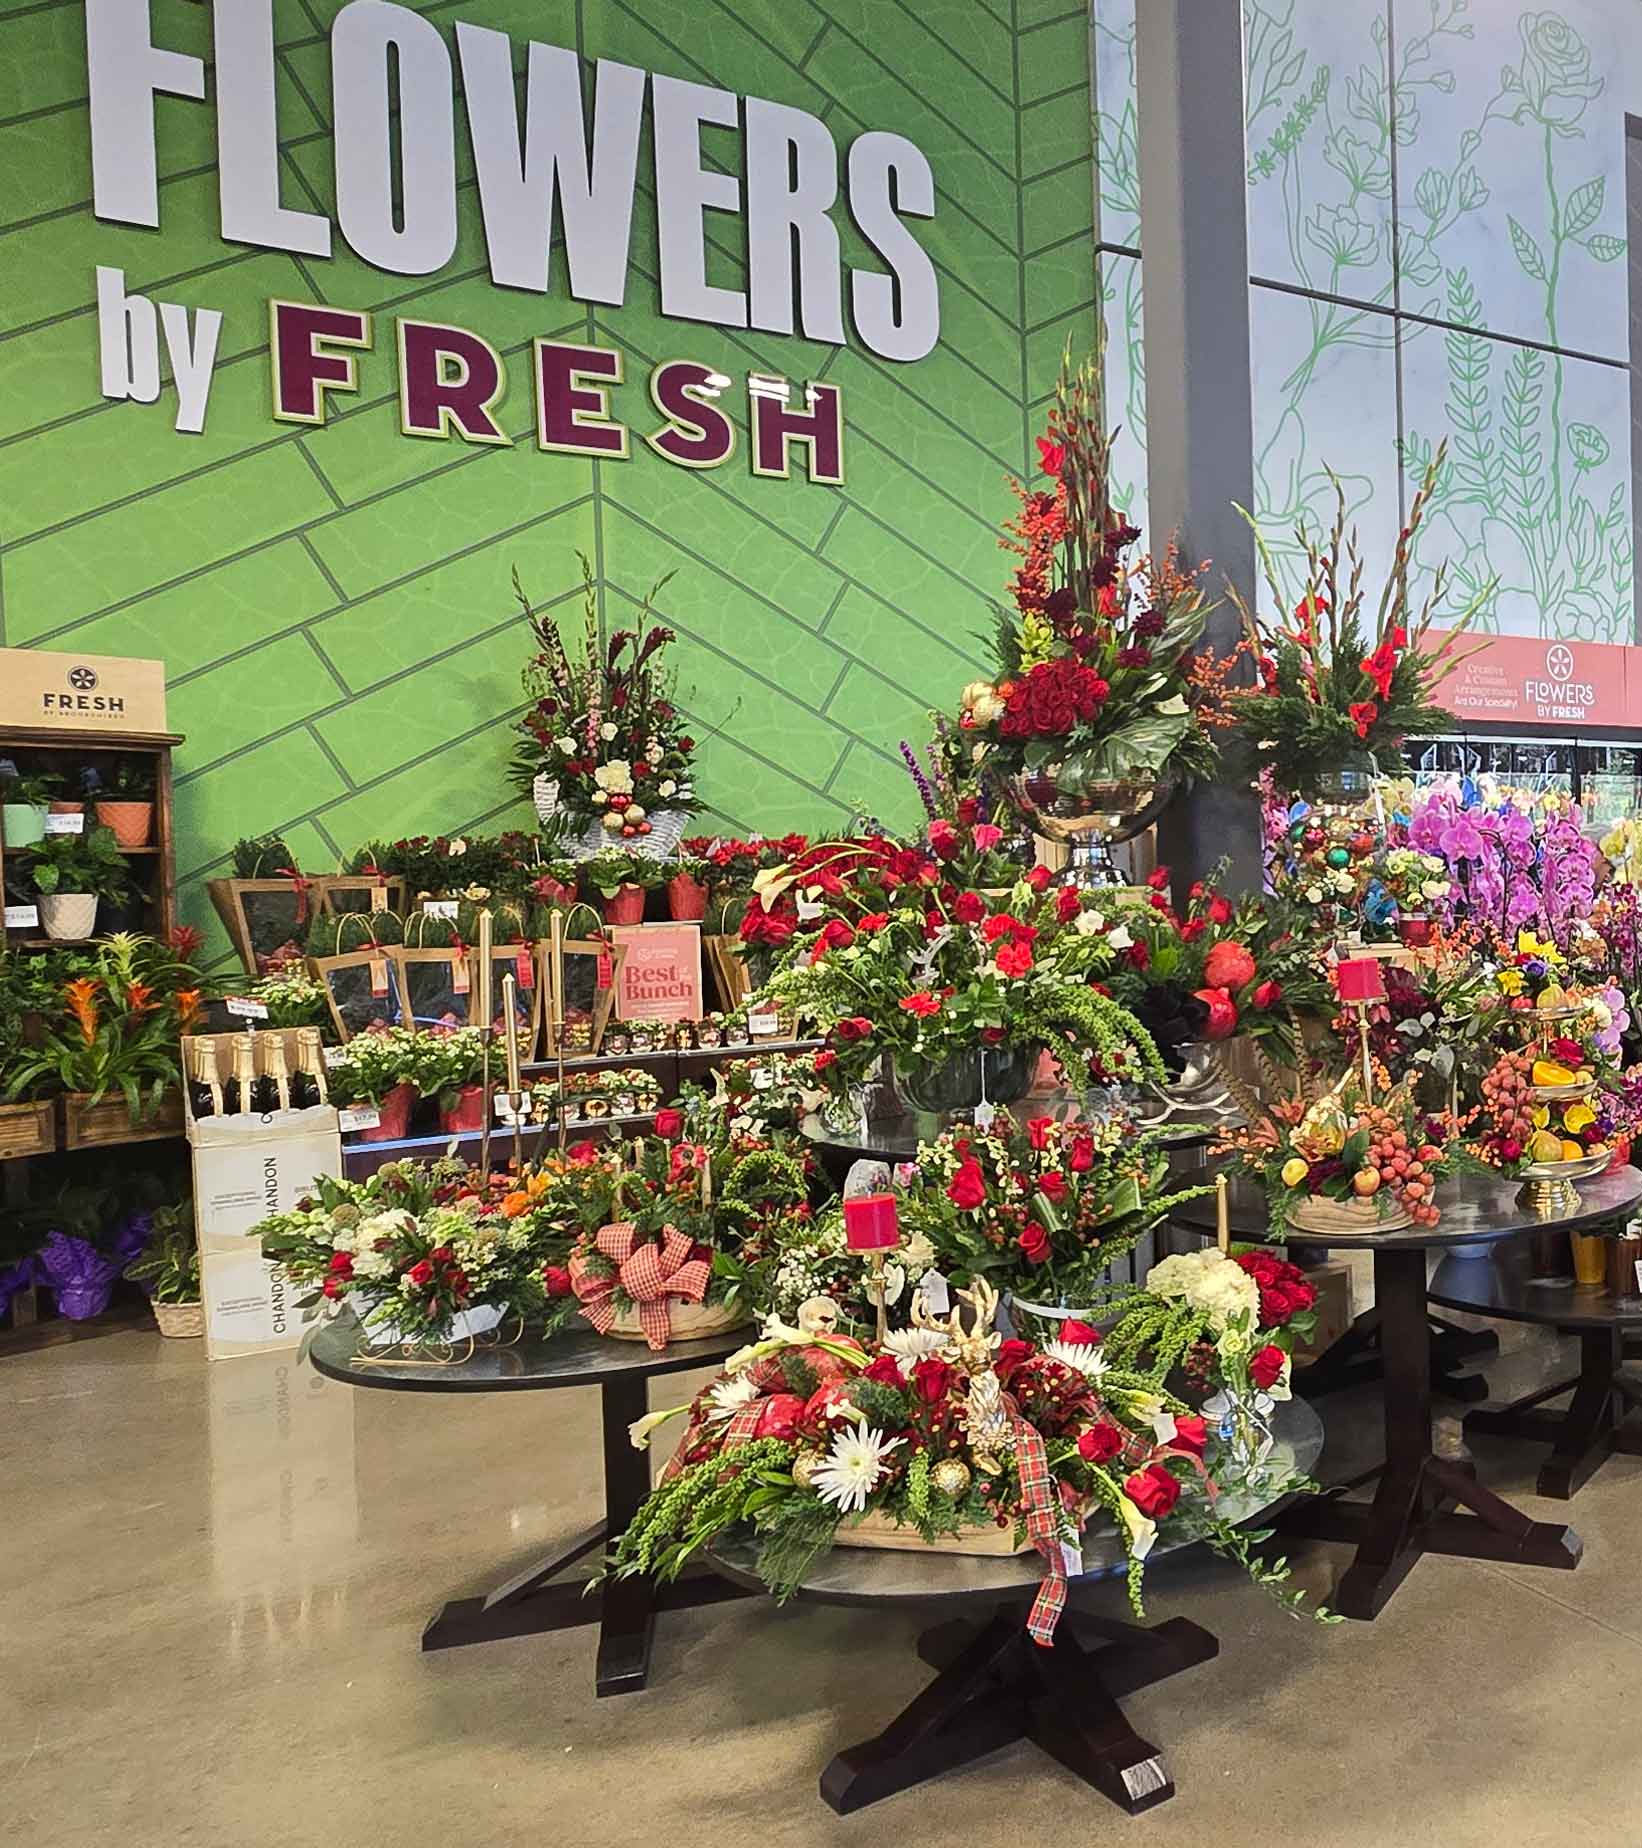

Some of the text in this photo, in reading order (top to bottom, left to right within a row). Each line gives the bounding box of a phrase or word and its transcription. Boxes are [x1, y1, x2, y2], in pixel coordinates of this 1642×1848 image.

[84, 0, 941, 363] FLOWERS
[96, 265, 847, 487] by FRESH
[43, 693, 125, 712] FRESH
[1525, 680, 1595, 705] FLOWERS
[1537, 705, 1585, 719] BY FRESH
[625, 965, 677, 984] Best
[626, 981, 693, 1001] Bunch
[263, 1157, 280, 1219] HANDON
[269, 1261, 287, 1335] CHANDON
